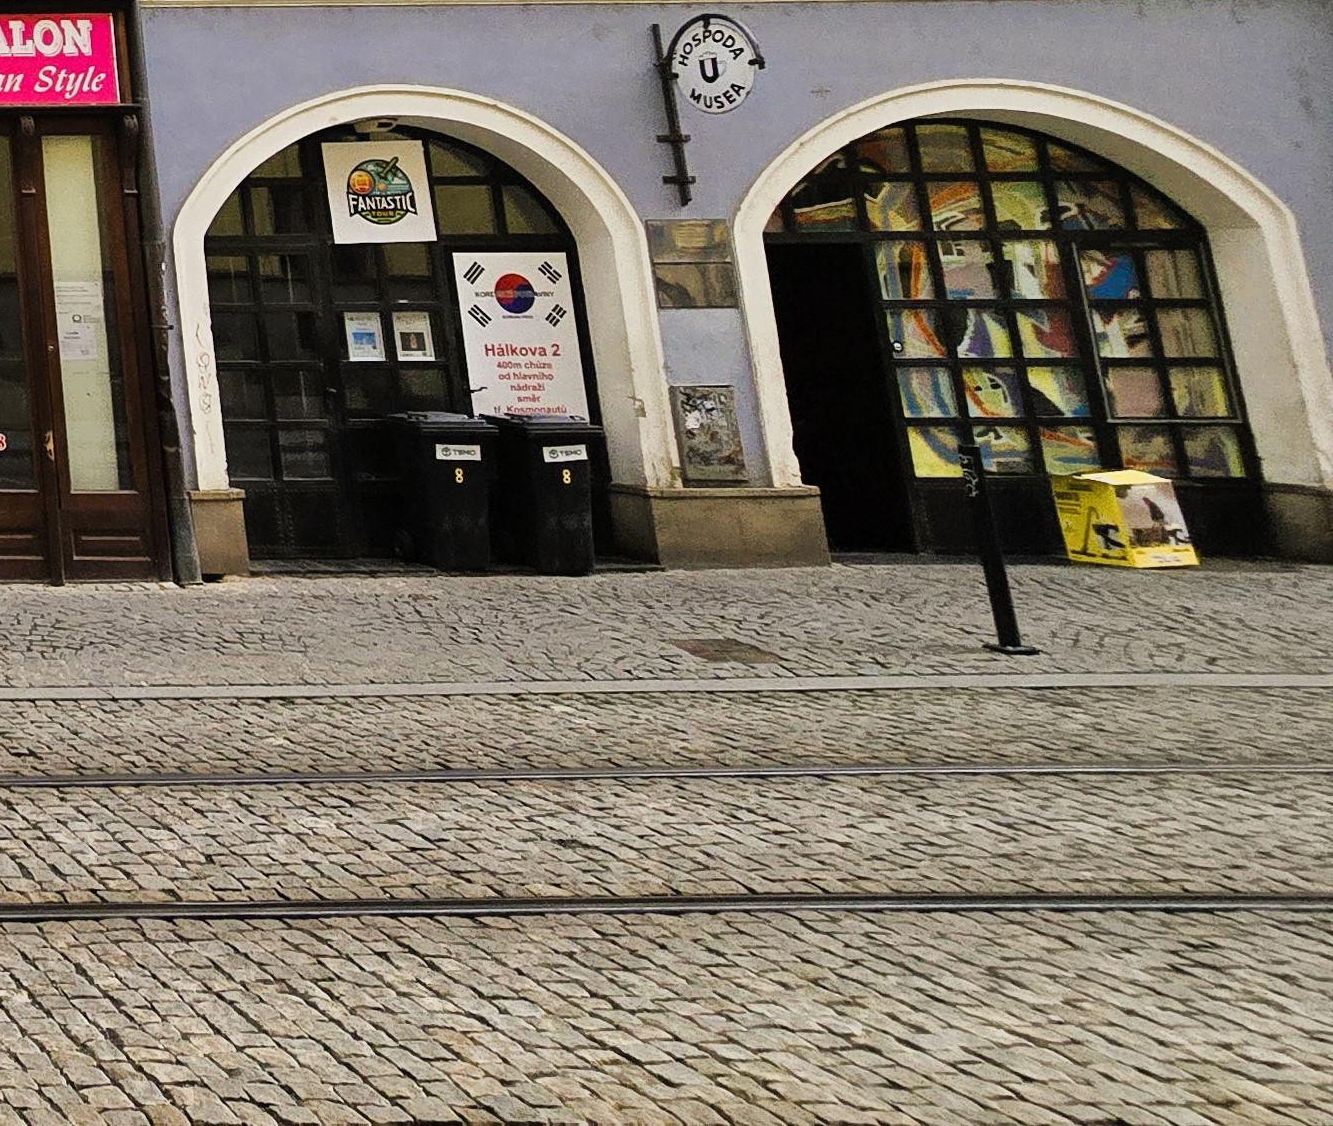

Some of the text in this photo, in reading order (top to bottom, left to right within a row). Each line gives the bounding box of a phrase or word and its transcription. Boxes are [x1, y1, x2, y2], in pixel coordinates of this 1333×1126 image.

[678, 30, 745, 67] HOSPODA
[34, 65, 107, 99] Style
[689, 83, 745, 109] MUSEA
[348, 193, 415, 214] FANTASTIC
[484, 342, 561, 358] Hálkova 2
[496, 360, 523, 370] 400m
[498, 372, 554, 382] od hlavního
[510, 383, 546, 392] nádraží
[517, 394, 542, 403] směr
[454, 467, 464, 484] 8
[561, 468, 572, 485] 8
